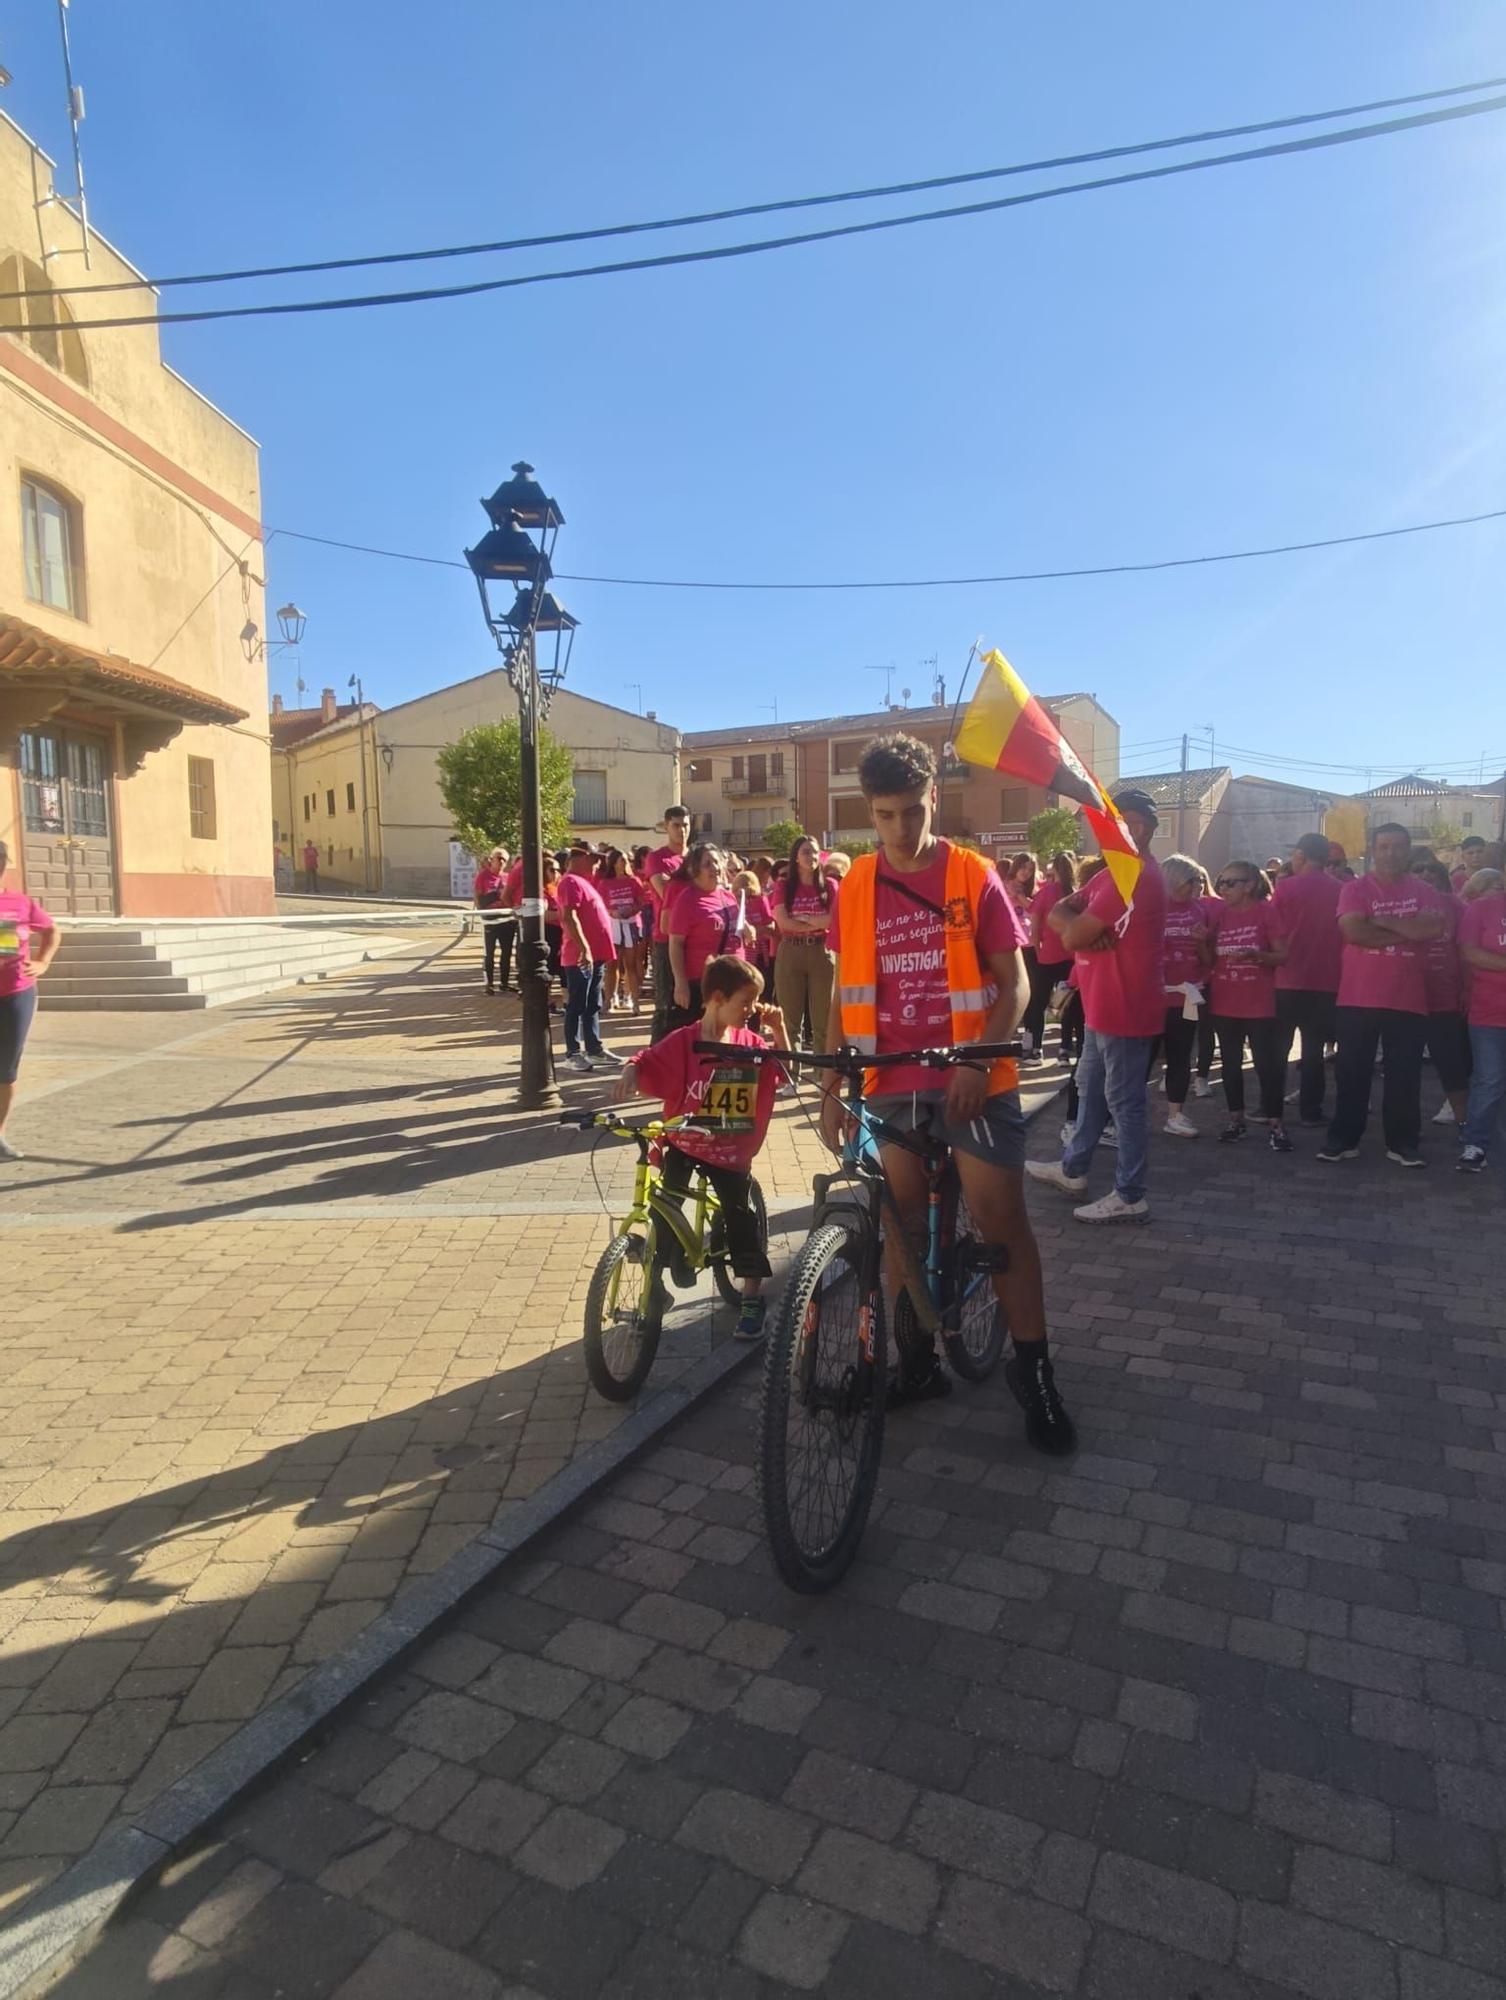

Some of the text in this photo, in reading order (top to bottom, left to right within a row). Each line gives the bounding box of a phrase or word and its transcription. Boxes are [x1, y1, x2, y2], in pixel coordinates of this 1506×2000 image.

[896, 914, 911, 926] no
[914, 910, 927, 922] se
[890, 932, 907, 944] un
[910, 924, 945, 944] segun
[881, 949, 946, 973] INVESTIGAC
[701, 1087, 749, 1114] 445
